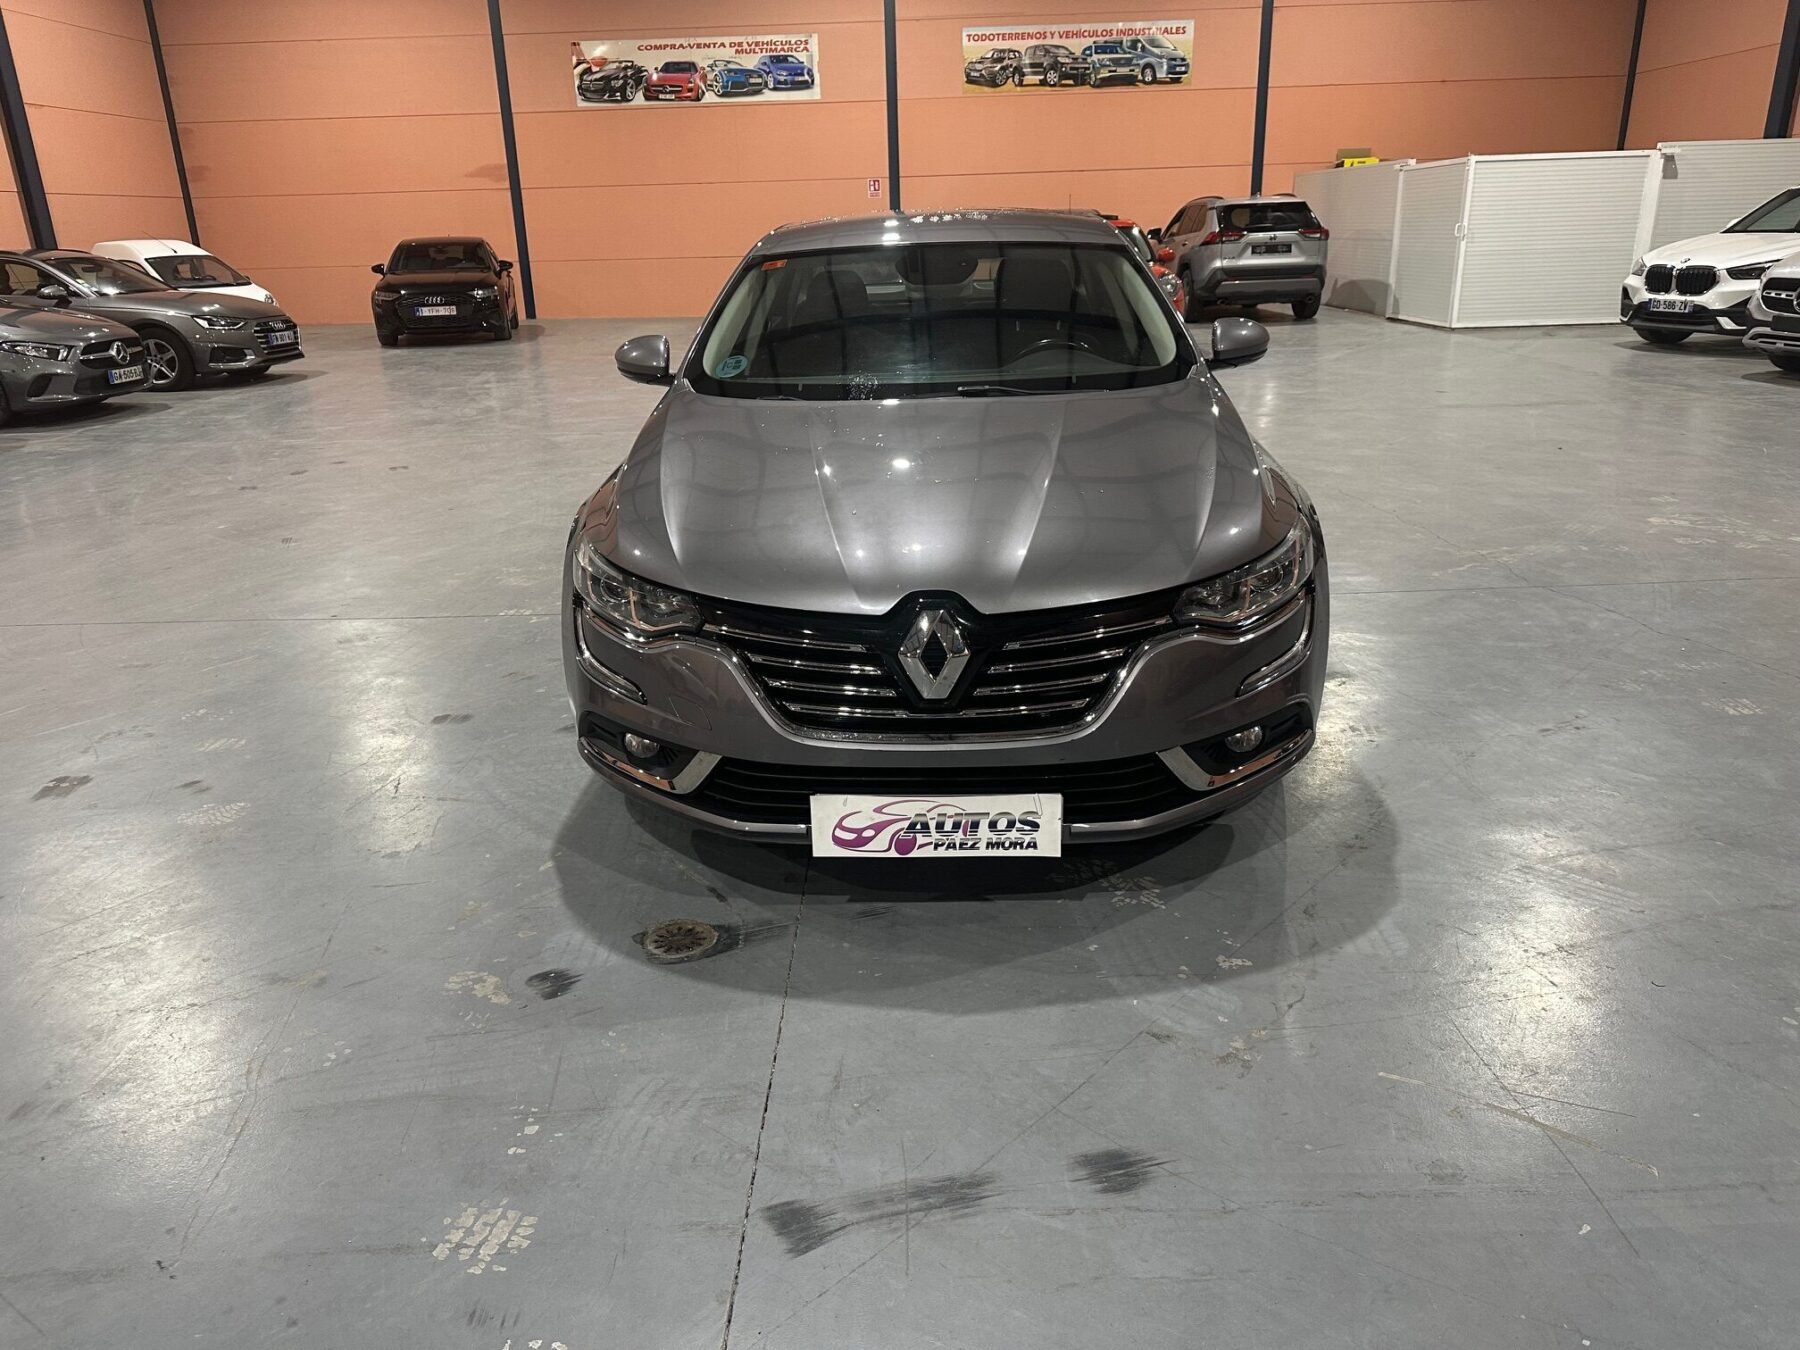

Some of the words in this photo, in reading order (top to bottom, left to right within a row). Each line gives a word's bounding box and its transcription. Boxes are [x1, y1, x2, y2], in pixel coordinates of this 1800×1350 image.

[966, 30, 1047, 43] TODOTERRENOS
[1049, 31, 1056, 40] Y
[1056, 28, 1114, 39] VEHÍCULOS
[637, 41, 726, 51] COMPRA-VENTA
[730, 40, 745, 49] DE
[746, 38, 809, 48] VEHÍCULOS
[735, 46, 810, 55] MULTIMARCA
[900, 811, 1041, 837] AUTOS
[985, 837, 1039, 851] MORA
